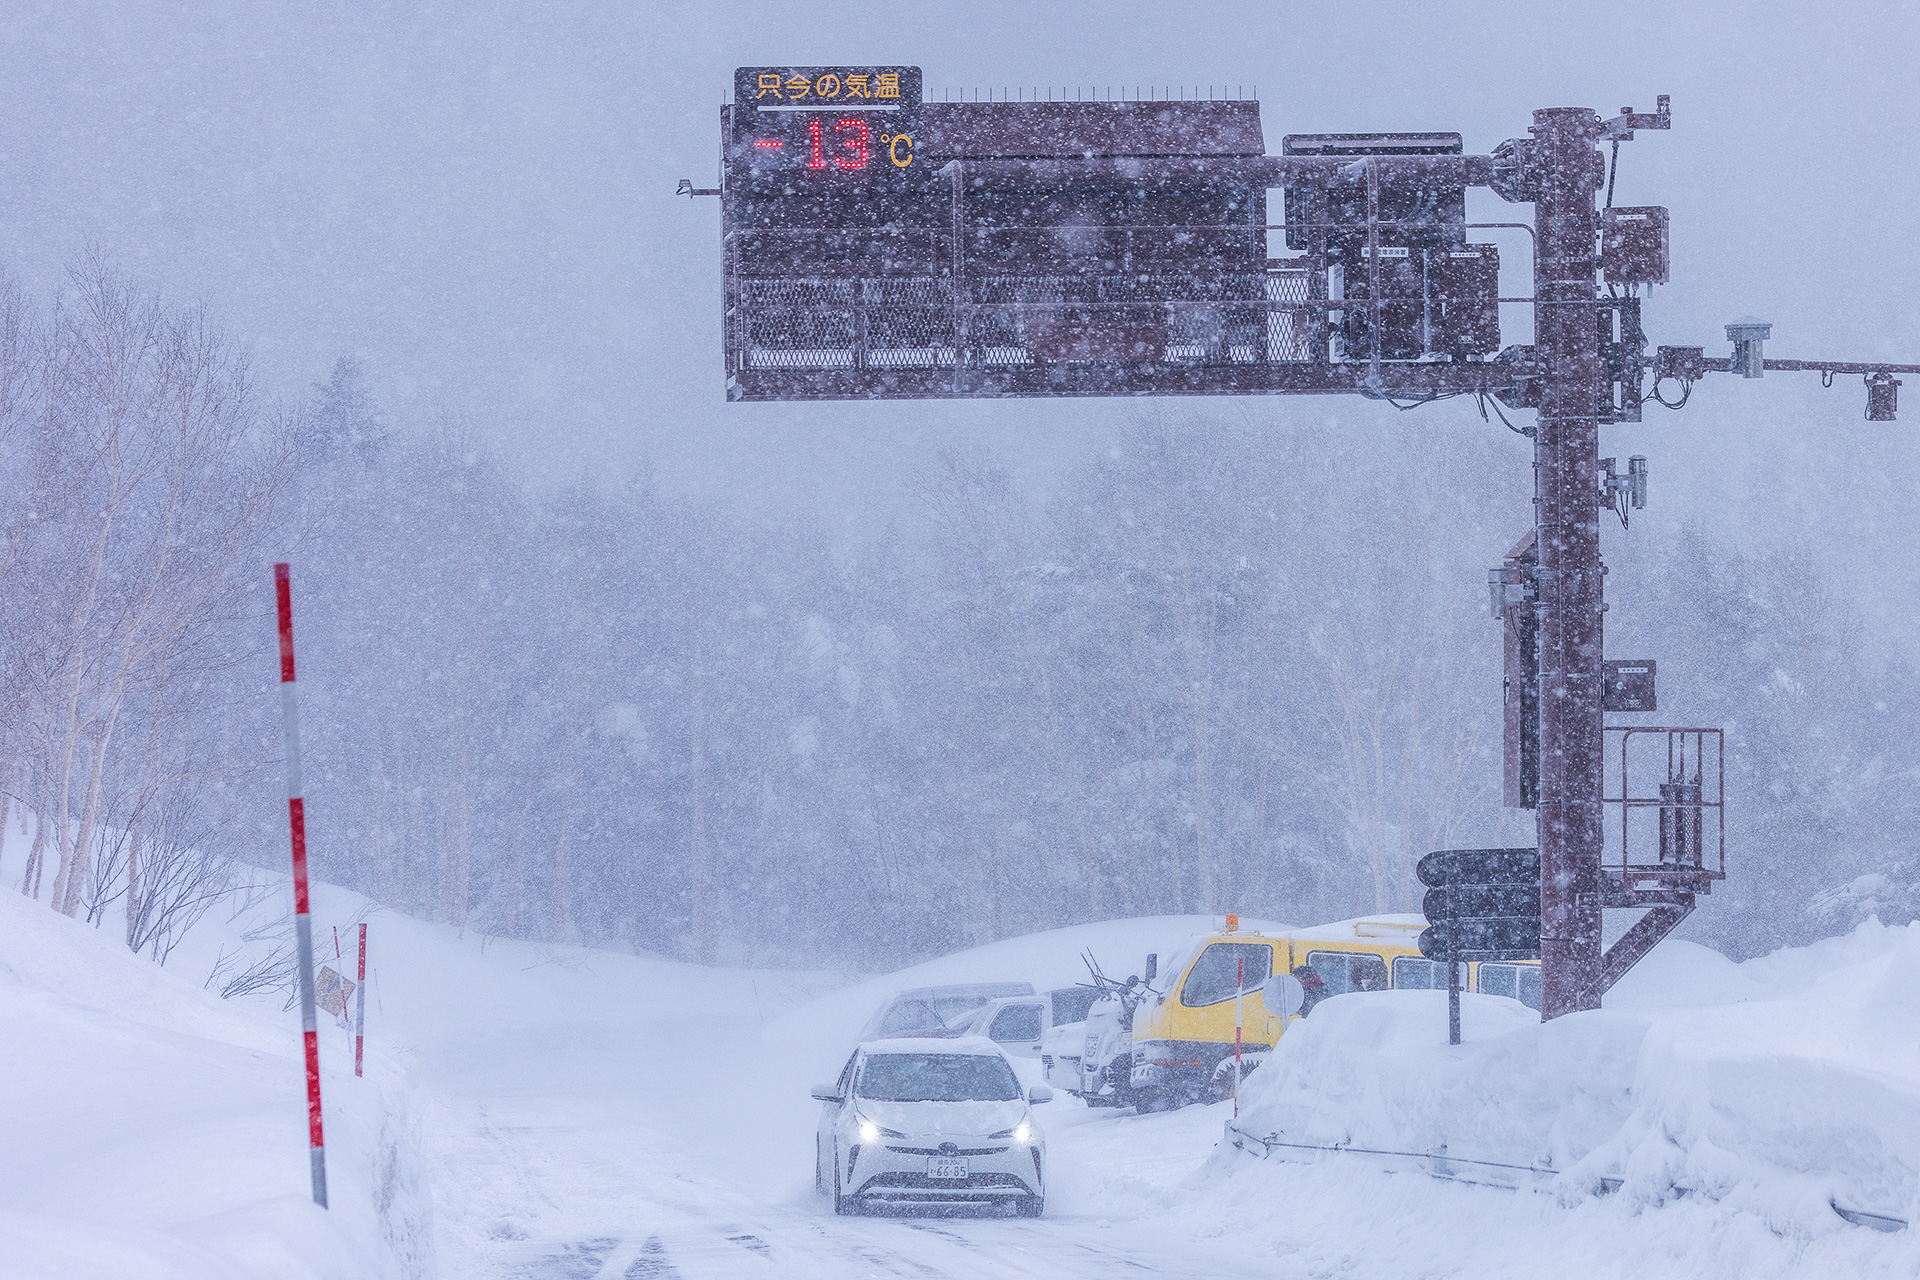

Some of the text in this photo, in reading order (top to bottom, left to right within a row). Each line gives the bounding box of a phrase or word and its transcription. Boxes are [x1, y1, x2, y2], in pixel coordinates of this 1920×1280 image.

[757, 73, 900, 99] 只今の気温
